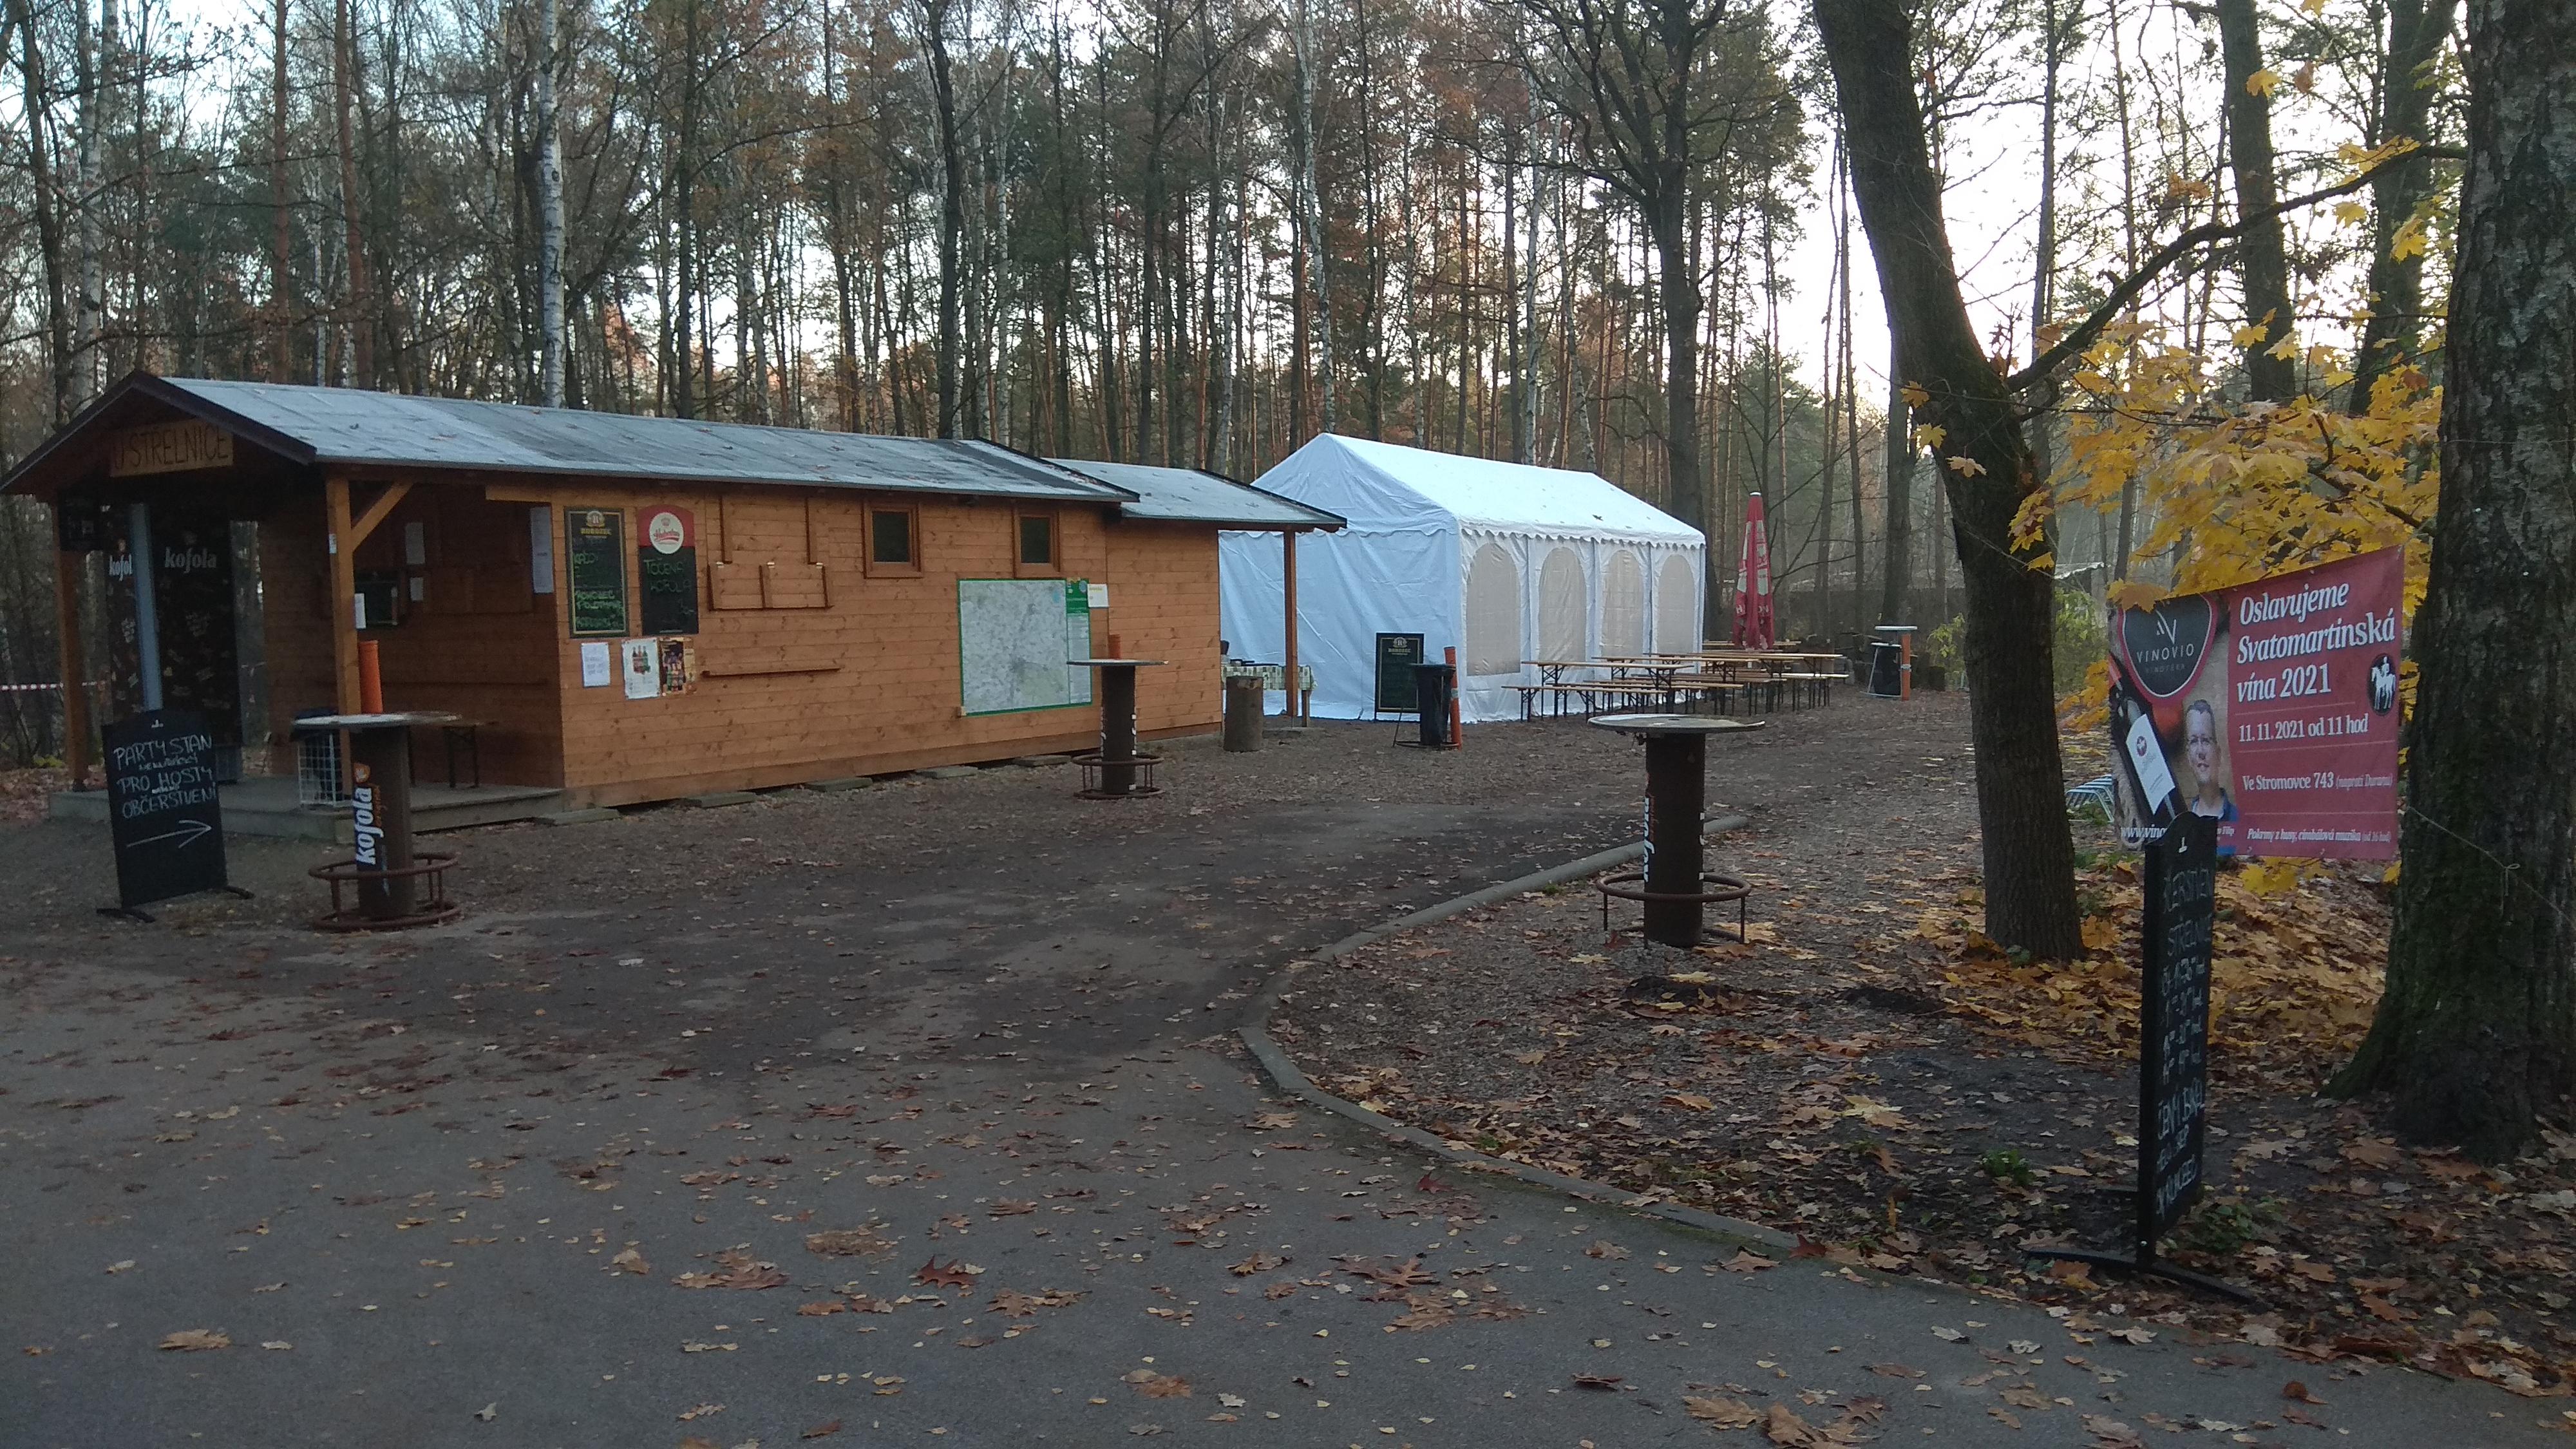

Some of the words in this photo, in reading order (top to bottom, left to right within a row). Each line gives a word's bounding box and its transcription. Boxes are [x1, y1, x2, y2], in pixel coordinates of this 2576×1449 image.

[108, 553, 133, 582] kofol
[165, 547, 217, 574] kofola
[2240, 583, 2349, 625] Oslavujeme
[2237, 608, 2396, 664] Svatomartinská
[2137, 643, 2195, 663] VINOVIO
[2237, 672, 2276, 703] vína
[2280, 663, 2331, 698] 2021
[2308, 717, 2324, 737] od
[2327, 715, 2343, 735] 11
[2345, 713, 2369, 734] hod
[113, 740, 167, 771] PARTY
[169, 734, 213, 755] STAN
[116, 775, 150, 794] PRO
[158, 766, 213, 789] HOSTY
[2242, 775, 2255, 790] Ve
[2256, 775, 2311, 790] Stromovce
[2313, 772, 2334, 788] 743
[122, 781, 217, 819] OBČERSTVENÍ
[353, 788, 384, 865] kofola
[2121, 824, 2168, 838] www.vino
